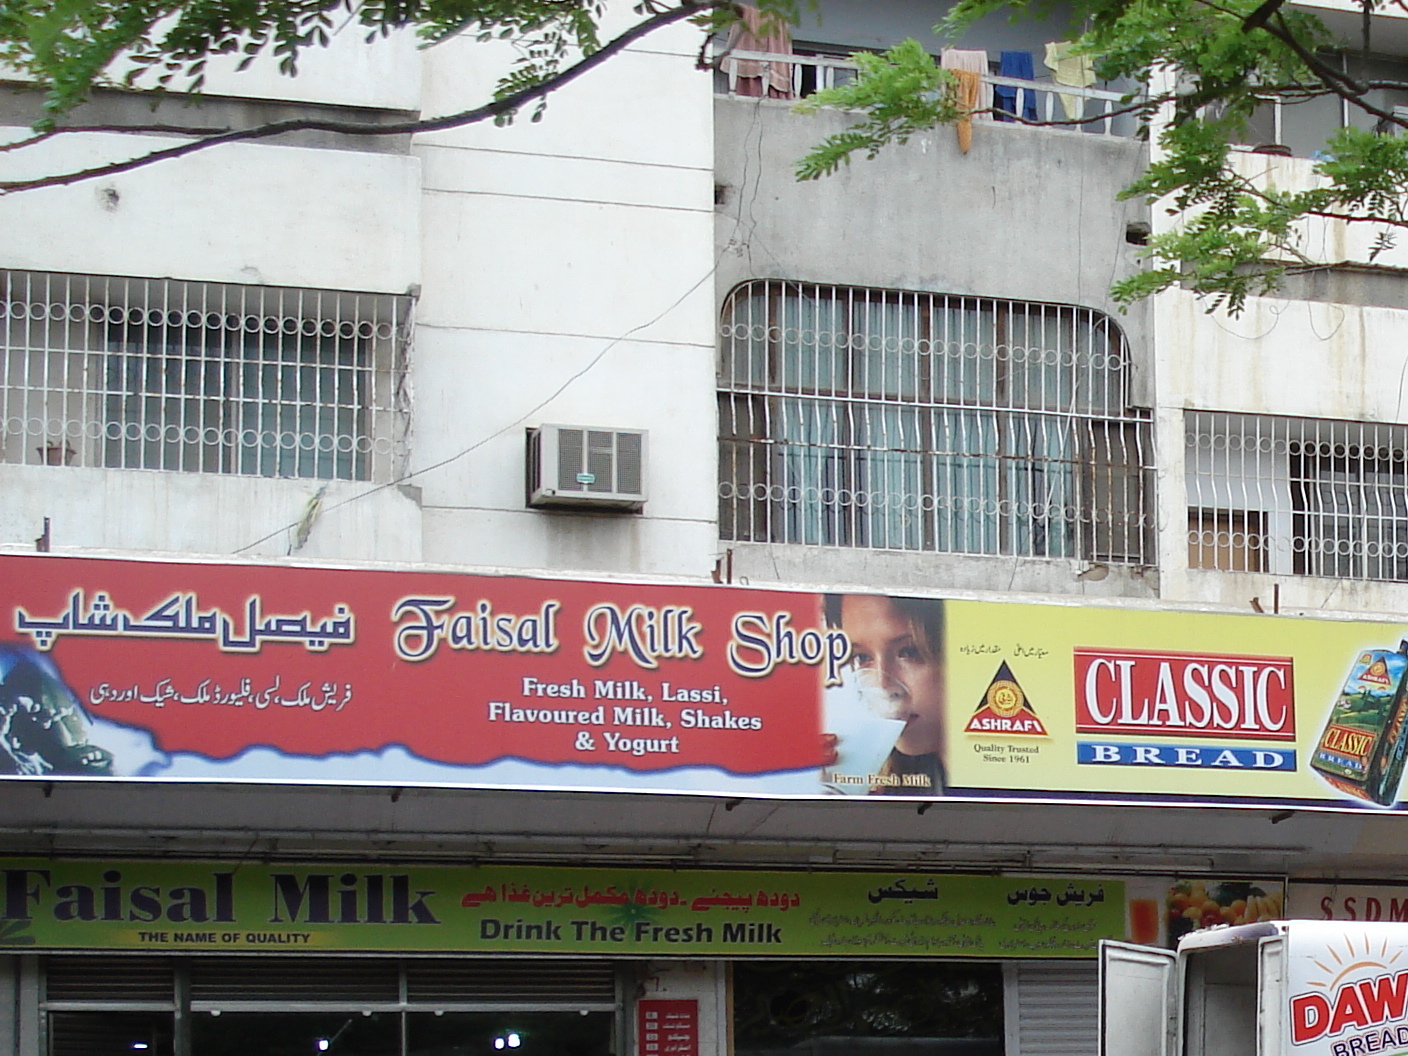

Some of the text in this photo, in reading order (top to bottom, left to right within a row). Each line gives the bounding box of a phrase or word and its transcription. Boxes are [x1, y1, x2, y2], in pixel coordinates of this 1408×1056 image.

[391, 594, 852, 687] Faisal Milk Shop
[521, 677, 729, 706] Fresh Milk, Lassi,
[1085, 658, 1287, 733] CLASSIC
[488, 702, 762, 731] Flavoured Milk, Shakes
[970, 718, 1042, 733] ASHRAFI
[575, 732, 680, 757] & Yogurt
[974, 744, 1039, 754] Quality Trusted
[1324, 728, 1373, 756] CLASSIC
[983, 754, 1030, 764] Since 1961
[1091, 745, 1284, 769] BREAD
[832, 773, 932, 788] Farm Fresh Milk
[1, 867, 442, 926] Faisal Milk
[139, 932, 311, 946] THE NAME OF QUALITY
[480, 918, 783, 944] Drink The Fresh Milk
